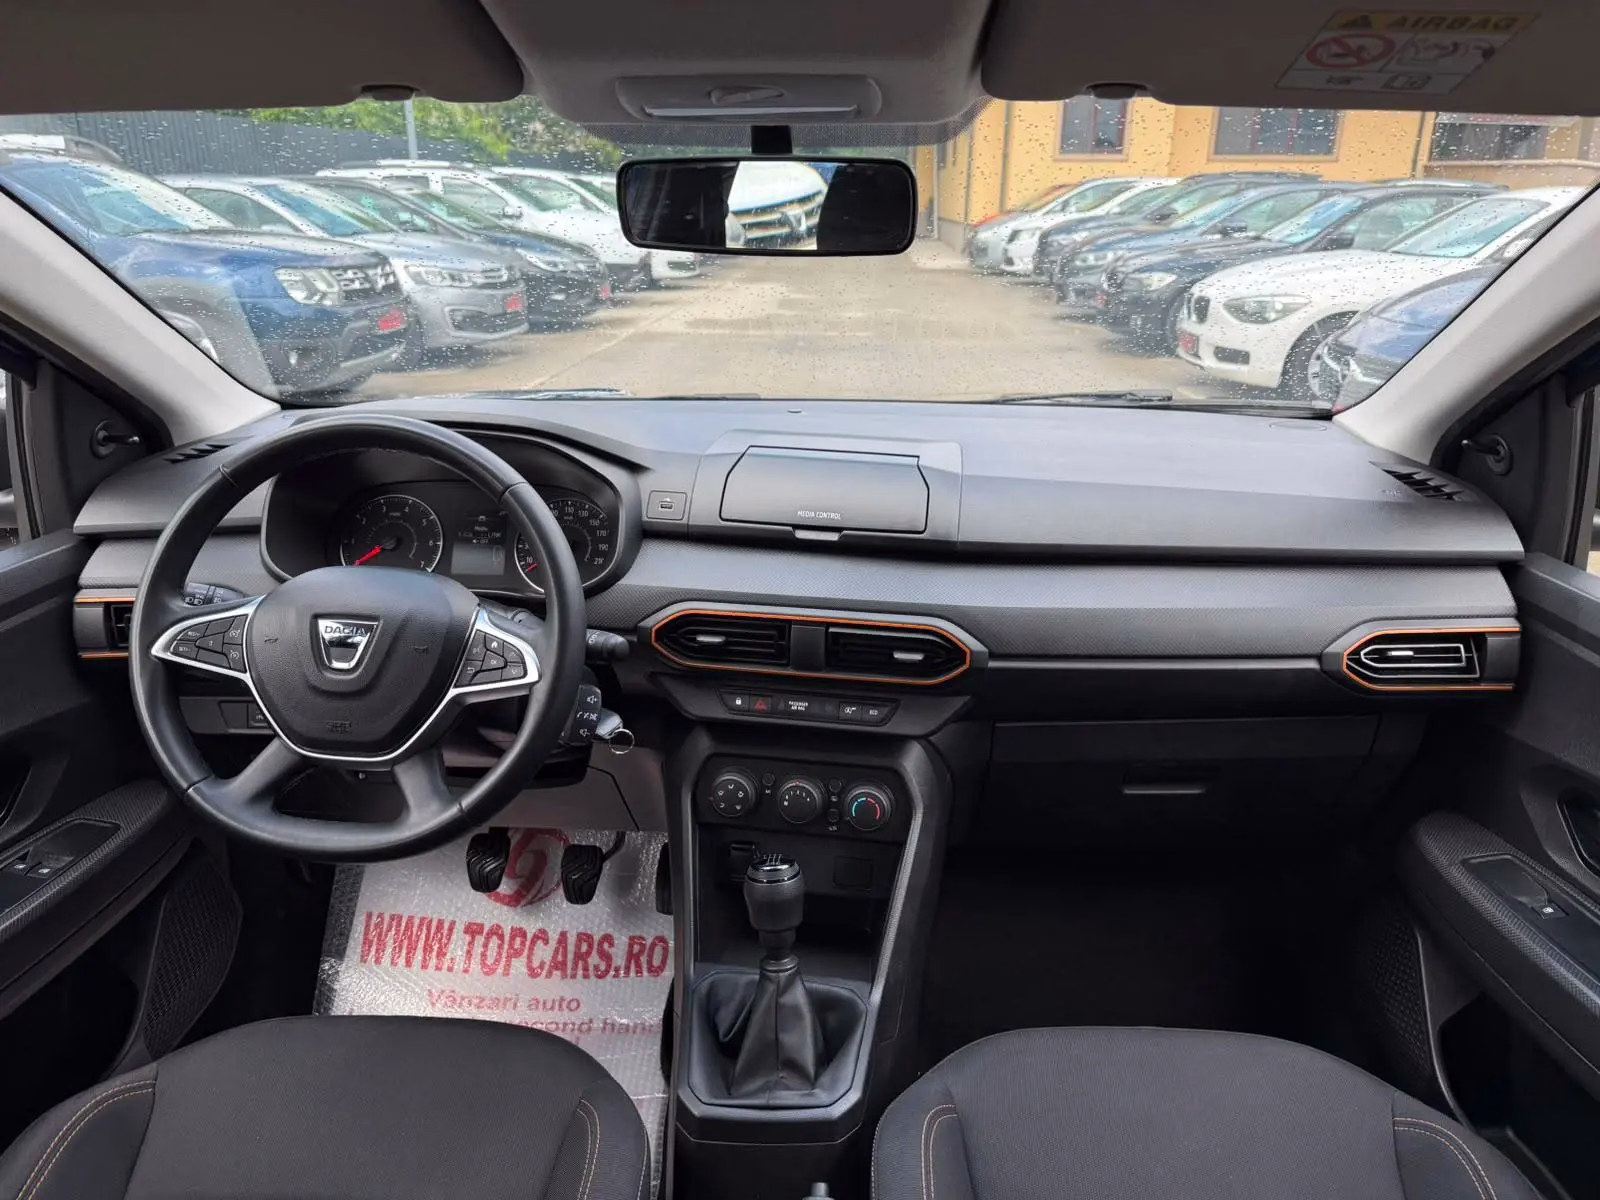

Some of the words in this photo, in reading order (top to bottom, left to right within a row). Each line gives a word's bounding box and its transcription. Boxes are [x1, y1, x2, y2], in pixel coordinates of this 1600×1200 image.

[1385, 15, 1519, 31] AIRBAG
[797, 510, 815, 518] MEDIA
[815, 511, 841, 520] CONTROL
[324, 624, 367, 637] DACIA
[359, 911, 671, 980] WWW.TOPCARS.RO
[526, 994, 581, 1013] auto
